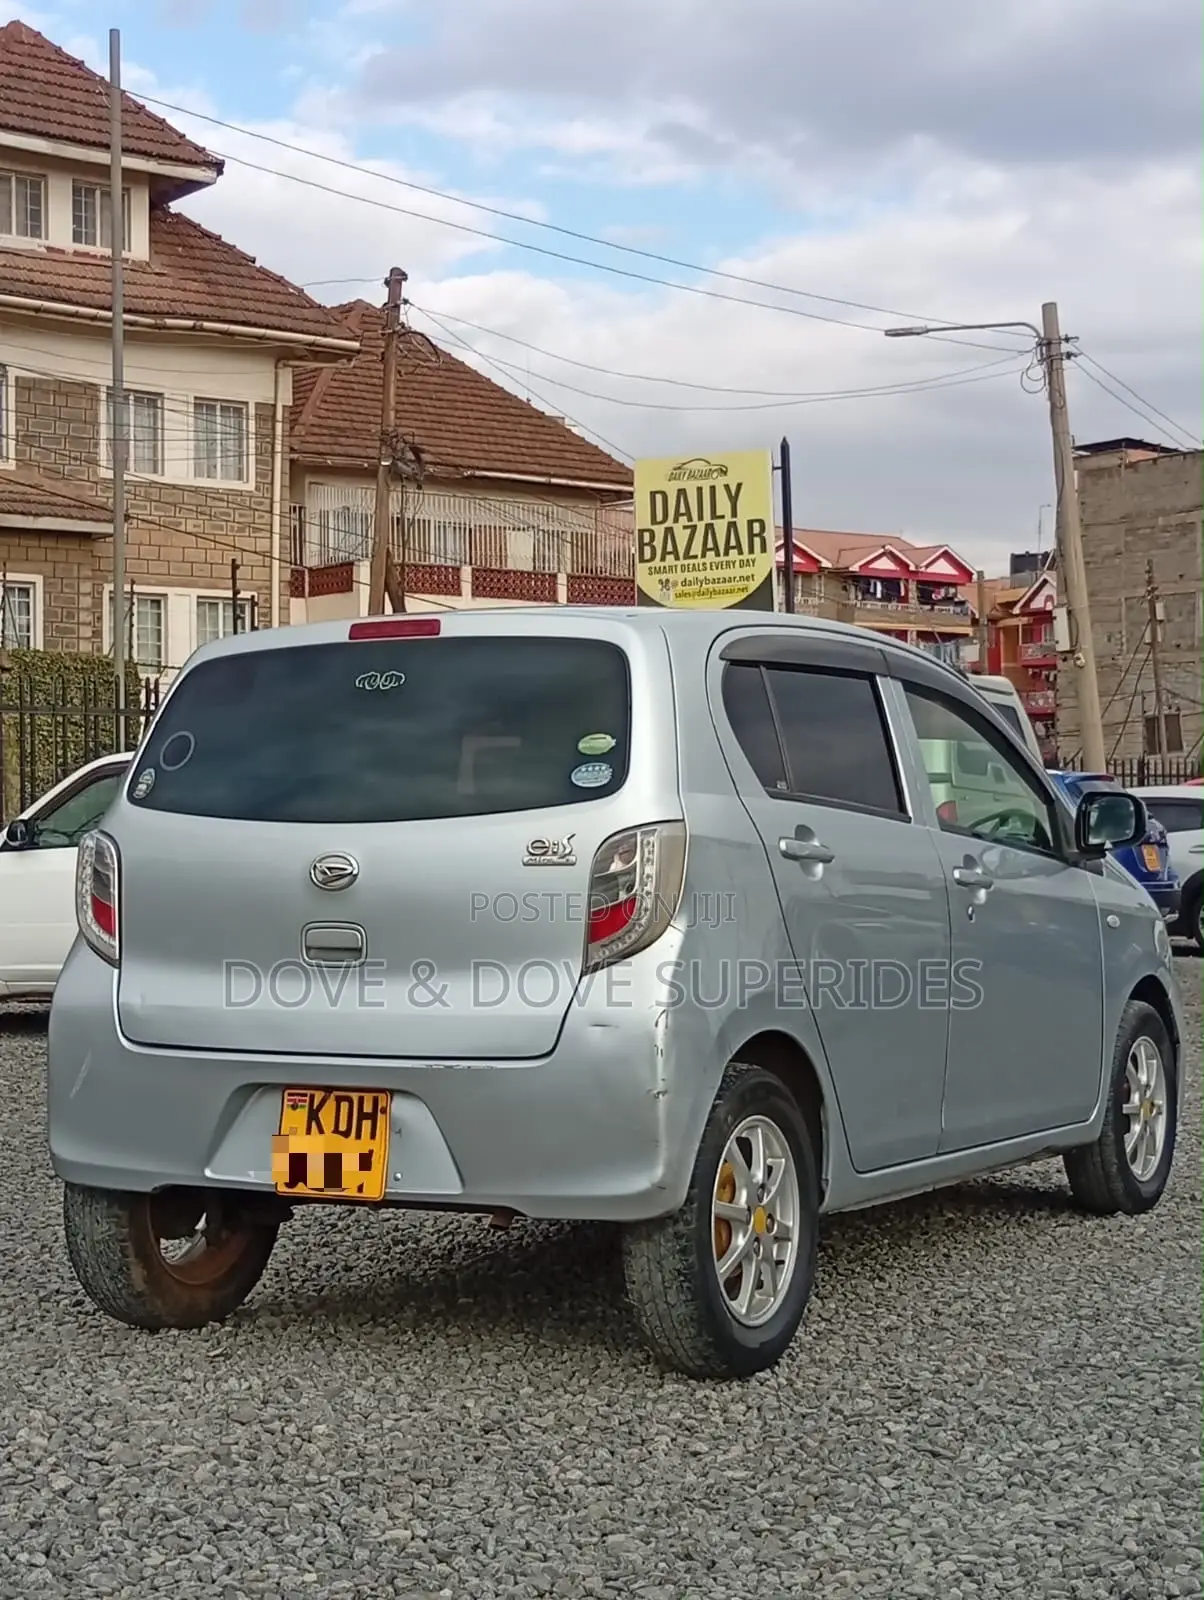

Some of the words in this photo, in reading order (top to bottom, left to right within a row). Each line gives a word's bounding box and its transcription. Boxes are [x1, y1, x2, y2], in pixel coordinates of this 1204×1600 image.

[649, 482, 743, 526] DAILY
[637, 518, 767, 564] BAZAAR
[647, 564, 678, 576] SMART
[680, 562, 708, 574] DEALS
[709, 559, 737, 571] EVERY
[739, 558, 757, 569] DAY
[680, 573, 756, 588] dailybazaar.net
[674, 585, 749, 599] sales@dailybazaar.net
[305, 1090, 379, 1140] KDH
